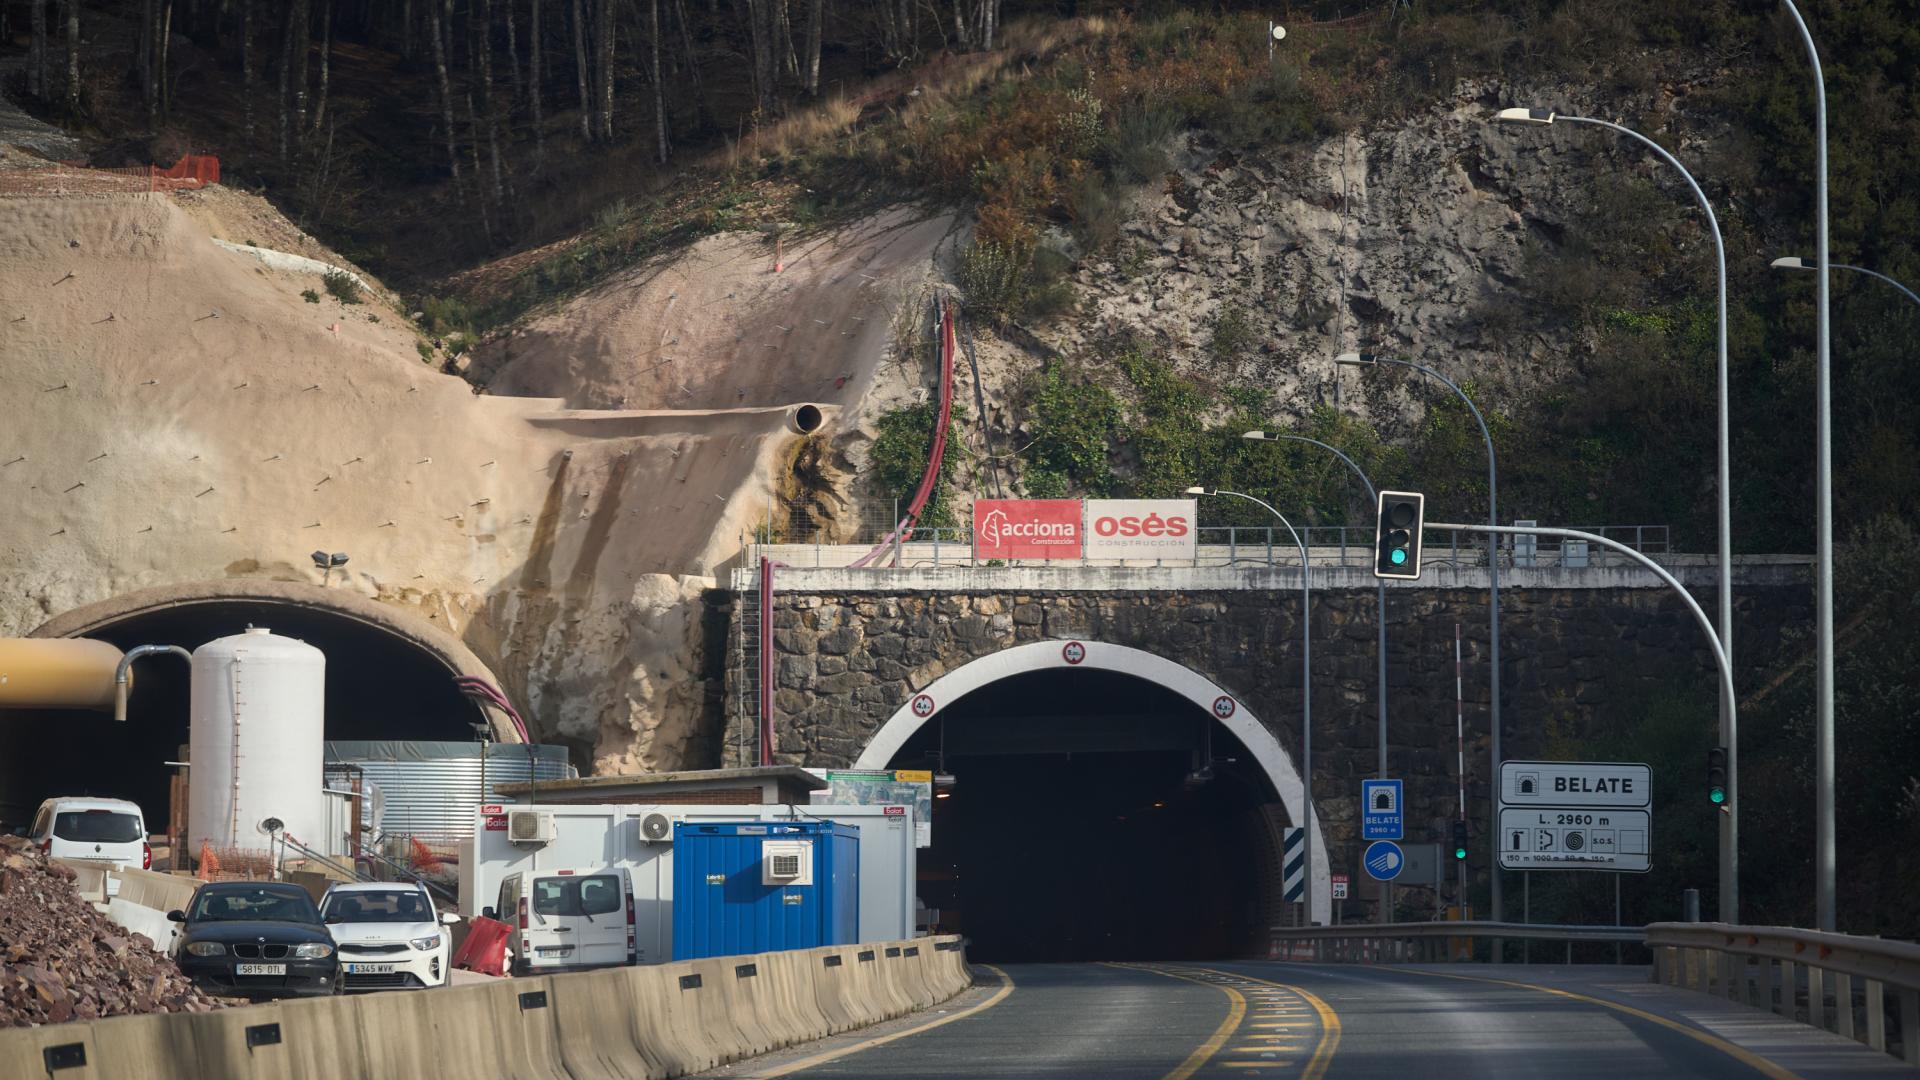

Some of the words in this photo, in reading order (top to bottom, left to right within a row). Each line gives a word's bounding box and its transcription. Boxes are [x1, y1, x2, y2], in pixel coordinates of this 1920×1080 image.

[1002, 519, 1075, 537] acciona
[1097, 539, 1185, 547] CONSTRUCCIÓN
[1555, 777, 1633, 793] BELATE
[487, 817, 508, 827] bala
[1365, 816, 1400, 824] BELATE
[1539, 814, 1551, 825] L.
[1557, 814, 1593, 825] 2960
[1599, 816, 1610, 826] m
[242, 965, 263, 974] 5815
[267, 965, 282, 974] DTL
[355, 964, 376, 973] 5345
[378, 964, 394, 972] MVK
